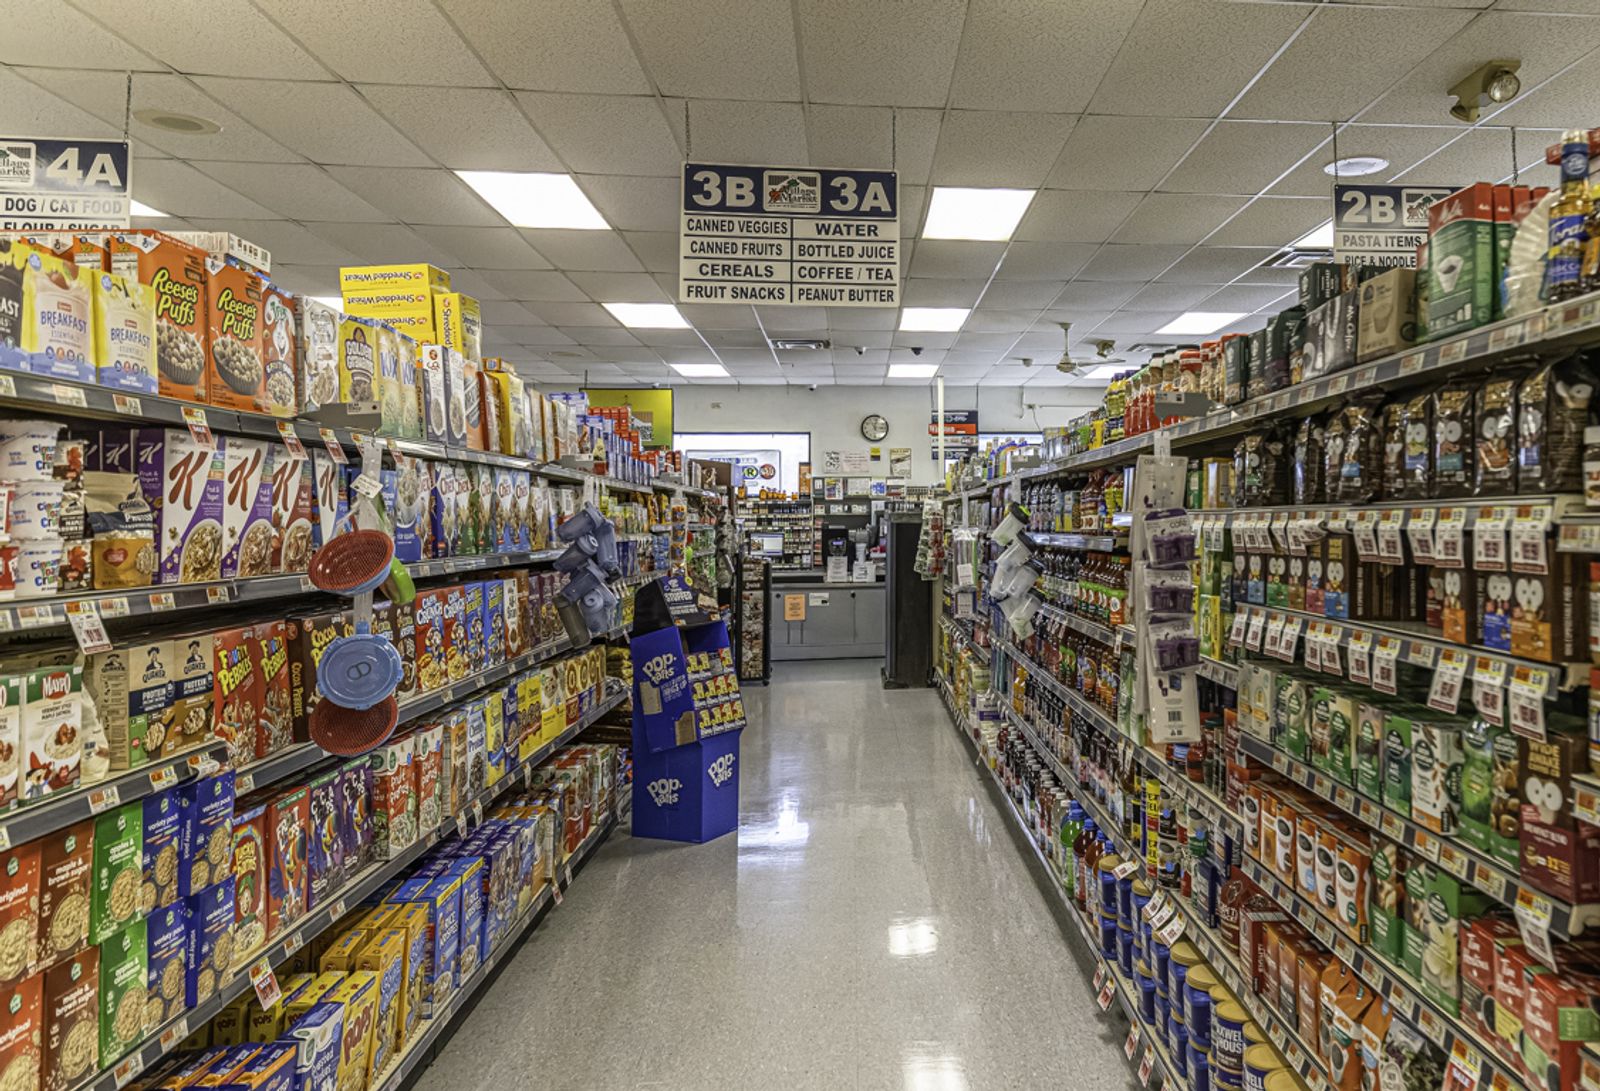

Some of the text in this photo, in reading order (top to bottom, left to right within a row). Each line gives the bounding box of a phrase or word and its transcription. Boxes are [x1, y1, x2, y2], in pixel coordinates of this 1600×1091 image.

[0, 168, 31, 176] arket
[46, 147, 122, 187] 4A
[692, 170, 756, 207] 3B
[829, 176, 892, 212] 3A
[5, 198, 37, 212] DOG
[49, 200, 78, 213] CAT
[82, 201, 122, 214] FOOD
[1342, 190, 1397, 224] 2B
[687, 218, 788, 234] CANNED VEGGIES
[815, 223, 879, 237] WATER
[690, 241, 783, 256] CANNED FRUITS
[1343, 235, 1422, 247] PASTA ITEMS
[798, 244, 895, 259] BOTTLED JUICE
[1345, 255, 1367, 267] RICE
[344, 271, 412, 282] Shredded Wheat
[699, 263, 774, 277] CEREALS
[798, 265, 894, 280] COFFEE / TEA
[152, 267, 199, 303] Reese's
[687, 285, 785, 300] FRUIT SNACKS
[217, 288, 257, 319] Reese's
[347, 294, 415, 305] Shredded Wheat
[798, 288, 894, 302] PEANUT BUTTER
[157, 295, 196, 325] Puffs
[40, 310, 87, 334] BREAKFAST
[222, 312, 255, 342] Puffs
[110, 328, 151, 348] BREAKFAST
[106, 443, 129, 466] K
[139, 442, 163, 465] K
[169, 451, 208, 511] K
[227, 448, 262, 512] K
[272, 458, 300, 513] K
[319, 464, 336, 513] K
[142, 671, 166, 683] QUAKER
[184, 661, 206, 675] QUAKER
[217, 655, 253, 697] PEBBLES
[43, 672, 71, 698] MAYPO
[184, 677, 207, 689] PROTEIN
[142, 687, 166, 701] PROTEIN
[202, 795, 231, 813] variety pack
[148, 812, 178, 831] variety pack
[48, 864, 89, 887] brown sugar
[206, 901, 234, 921] variety pack
[153, 923, 185, 947] variety pack
[253, 1014, 273, 1028] POPS
